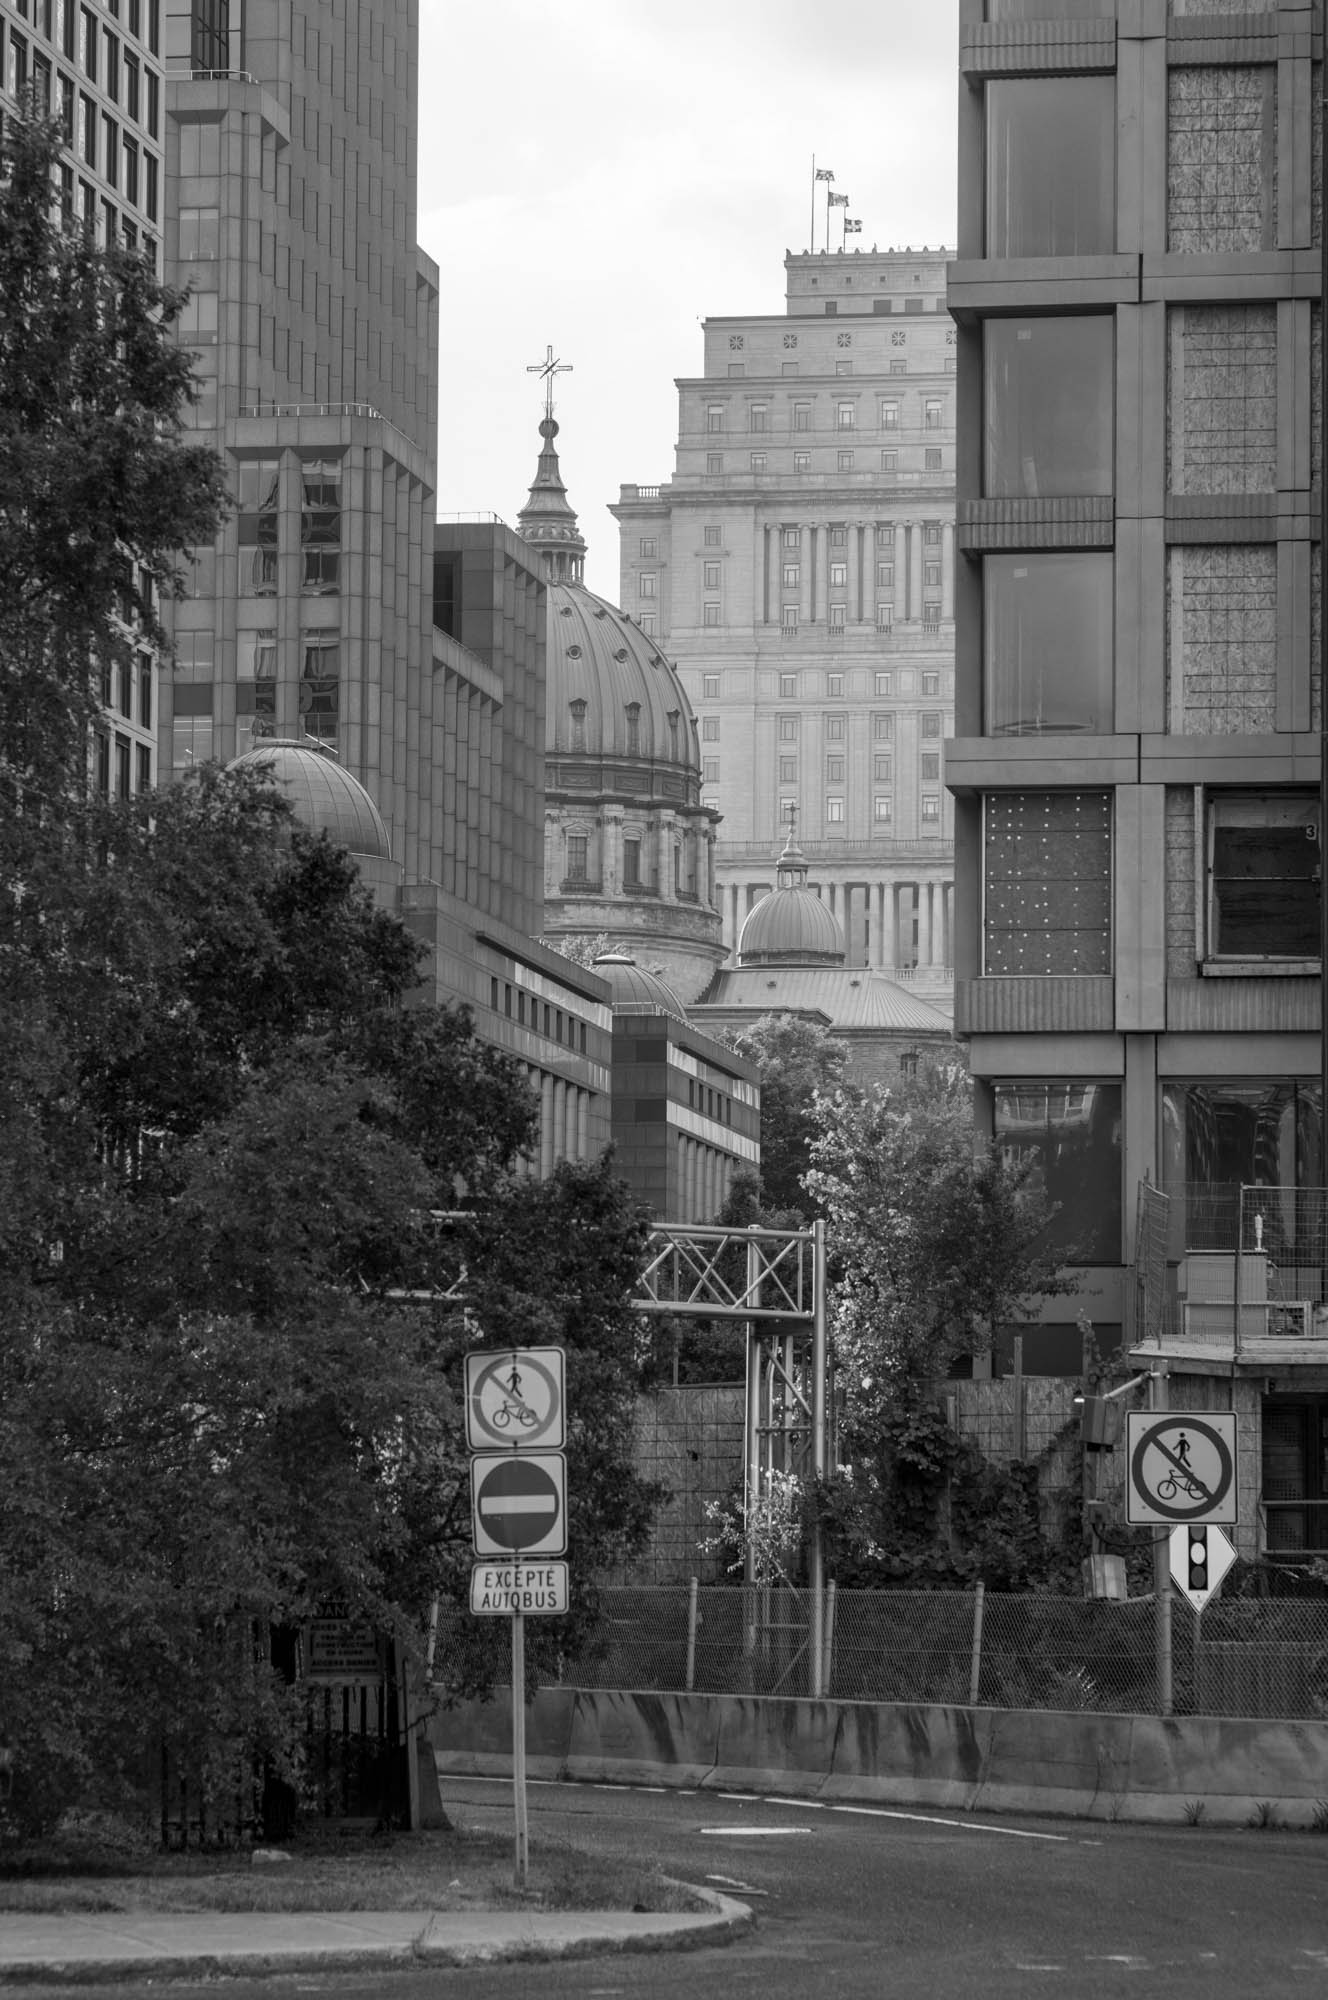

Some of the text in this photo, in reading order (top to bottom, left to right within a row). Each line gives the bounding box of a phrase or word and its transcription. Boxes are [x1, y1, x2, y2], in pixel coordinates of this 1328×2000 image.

[1307, 824, 1315, 838] 3
[484, 1567, 555, 1588] EXCEPTÉ
[481, 1591, 557, 1609] AUTOBUS
